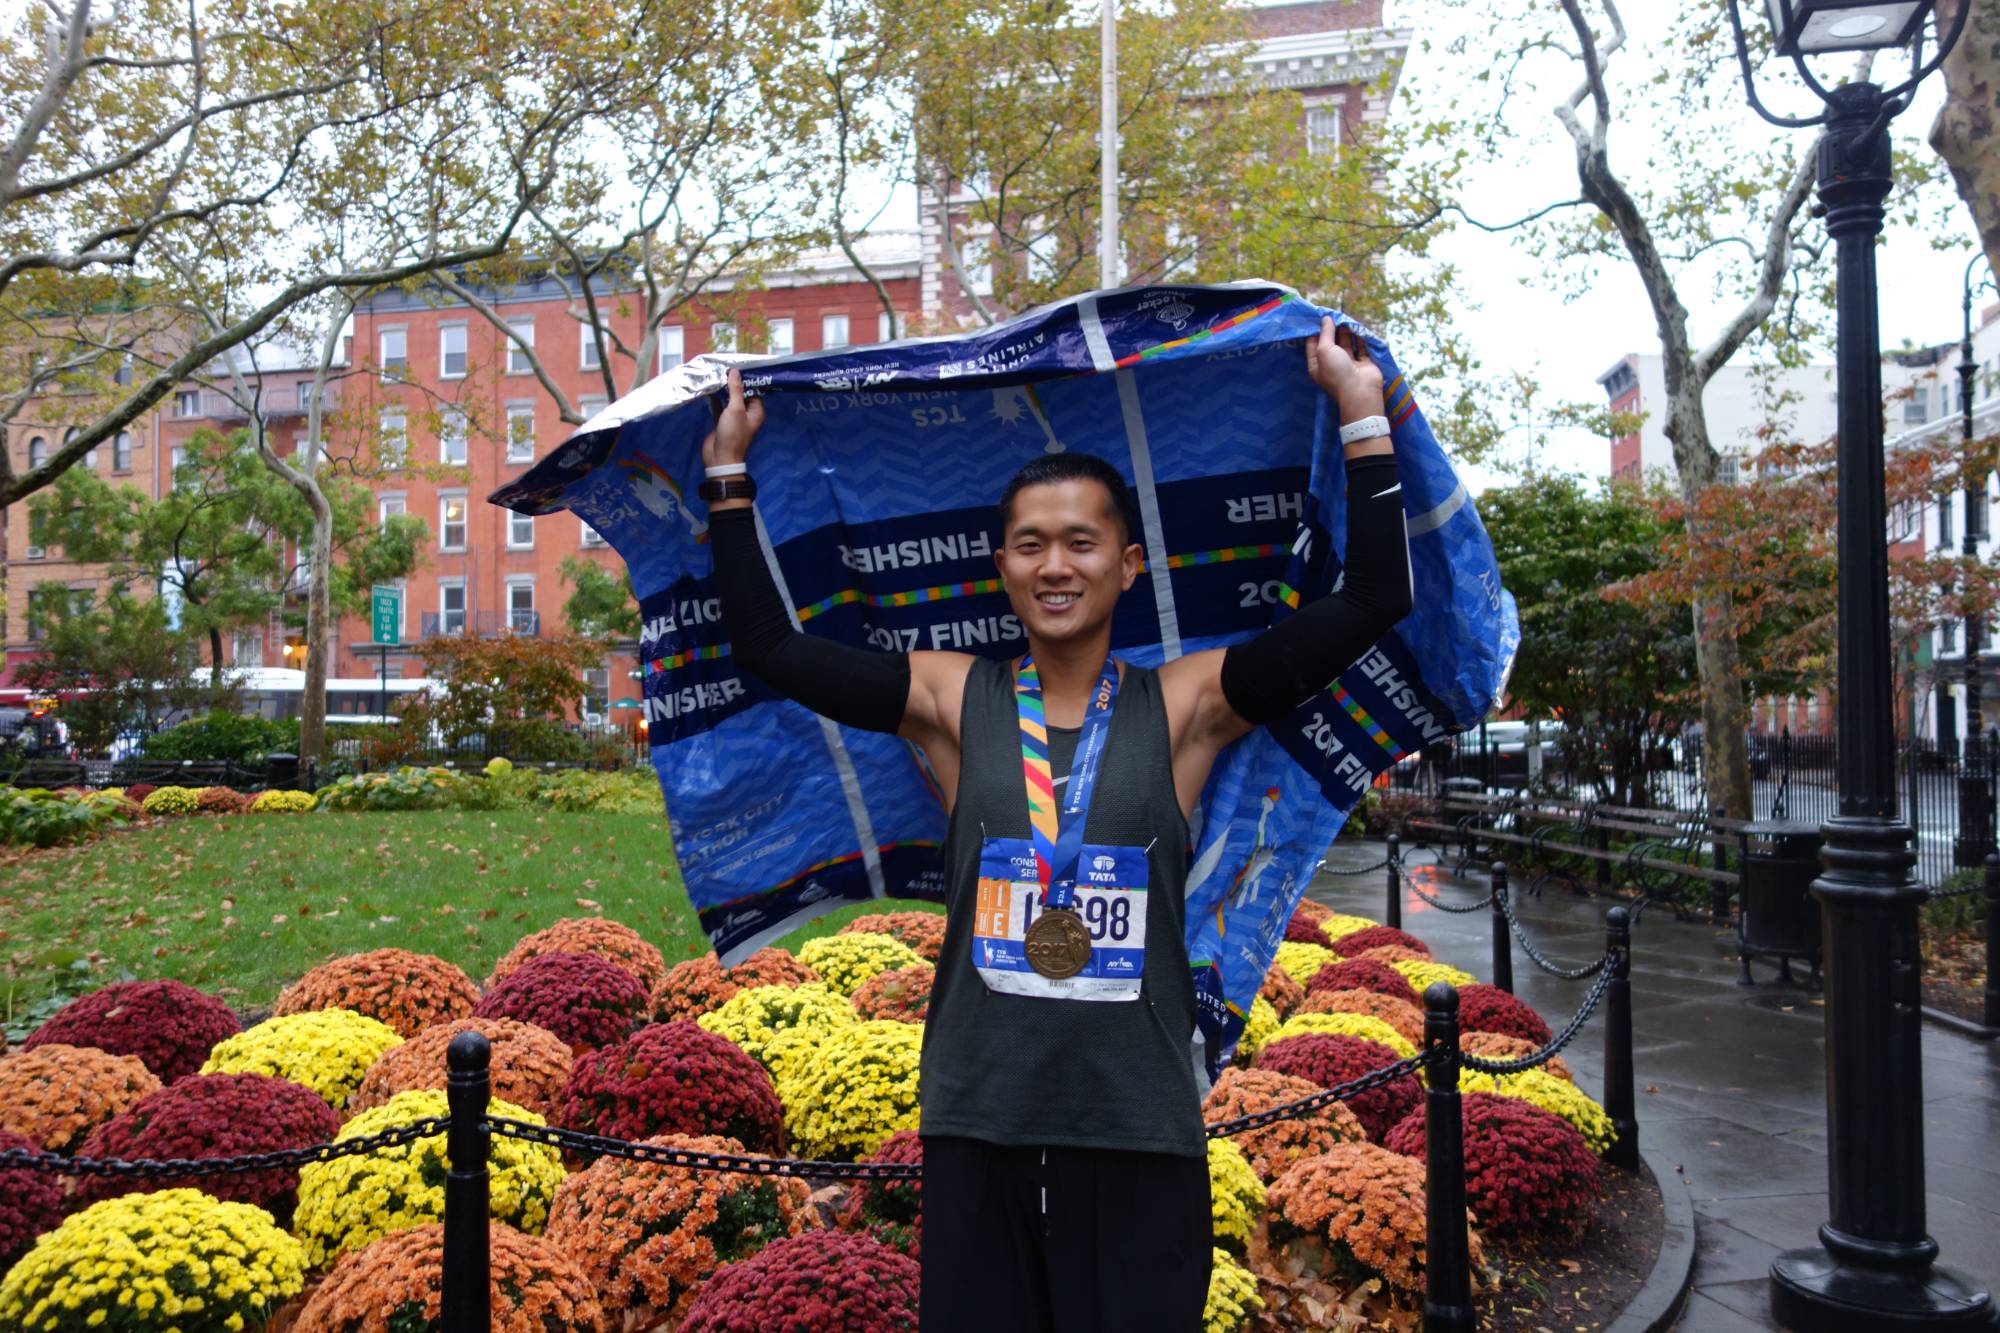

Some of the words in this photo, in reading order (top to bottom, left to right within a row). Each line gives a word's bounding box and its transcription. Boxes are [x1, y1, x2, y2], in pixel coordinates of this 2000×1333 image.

[966, 333, 1044, 370] AIRLINES
[795, 397, 841, 415] CITY
[850, 392, 904, 409] YORK
[911, 404, 966, 428] TCS
[838, 531, 991, 573] FINISHER
[863, 623, 920, 653] 2017
[930, 613, 1030, 651] FINIS
[1095, 678, 1113, 711] 2017
[1088, 871, 1117, 883] TATA
